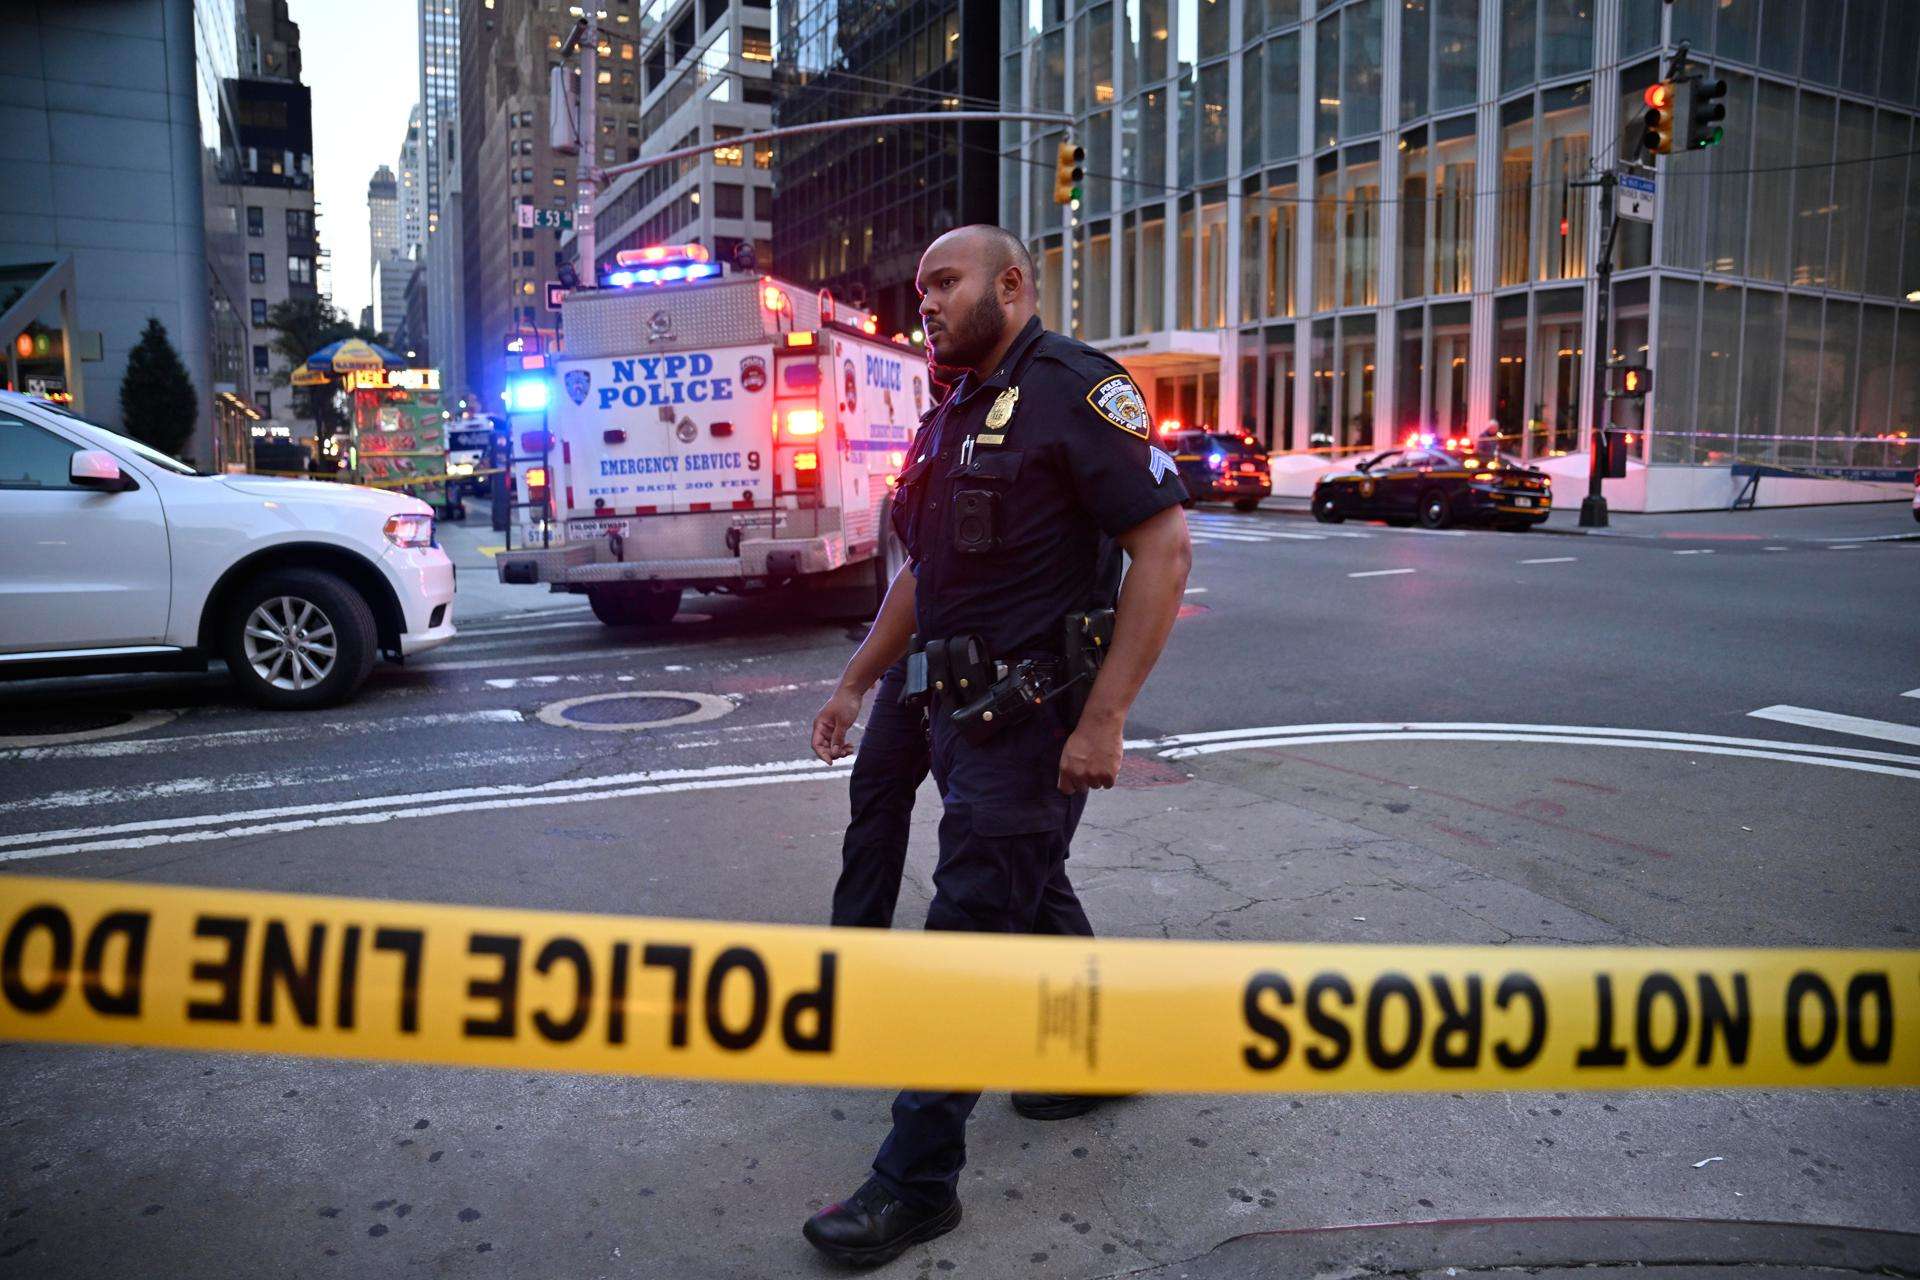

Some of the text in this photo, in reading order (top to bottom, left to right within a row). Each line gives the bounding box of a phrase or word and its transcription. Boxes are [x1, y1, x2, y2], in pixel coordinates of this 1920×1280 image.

[534, 209, 541, 225] E
[546, 210, 560, 228] 53
[612, 353, 713, 383] NYPD
[866, 354, 901, 392] POLICE
[598, 378, 733, 409] POLICE
[1100, 379, 1124, 395] POLICE
[1108, 412, 1126, 425] CITY
[601, 451, 761, 476] EMERGENCY SERVICE 9
[589, 479, 760, 495] KEEP BACK 200 FEET
[2, 904, 839, 1054] POLICE LINE DO
[1241, 969, 1893, 1073] DO NOT CROSS
